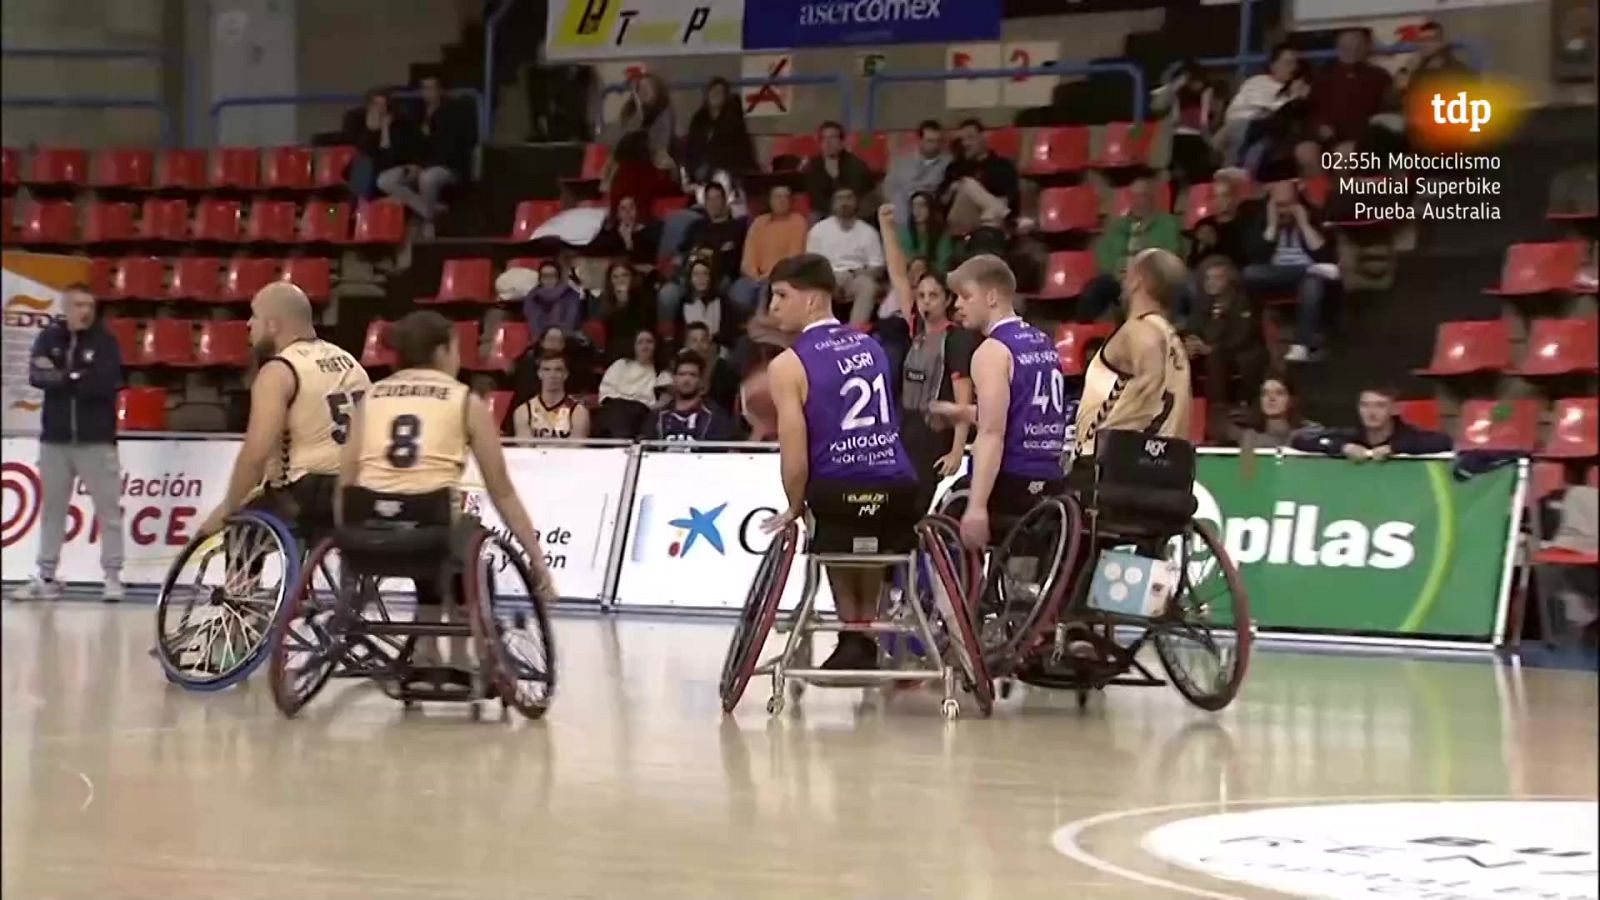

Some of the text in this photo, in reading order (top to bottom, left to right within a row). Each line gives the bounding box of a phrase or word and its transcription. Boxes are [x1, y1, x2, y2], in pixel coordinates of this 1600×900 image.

[837, 351, 874, 375] LASRI
[839, 373, 891, 431] 21
[1032, 369, 1065, 415] 40
[387, 414, 421, 468] 8
[546, 526, 572, 545] de
